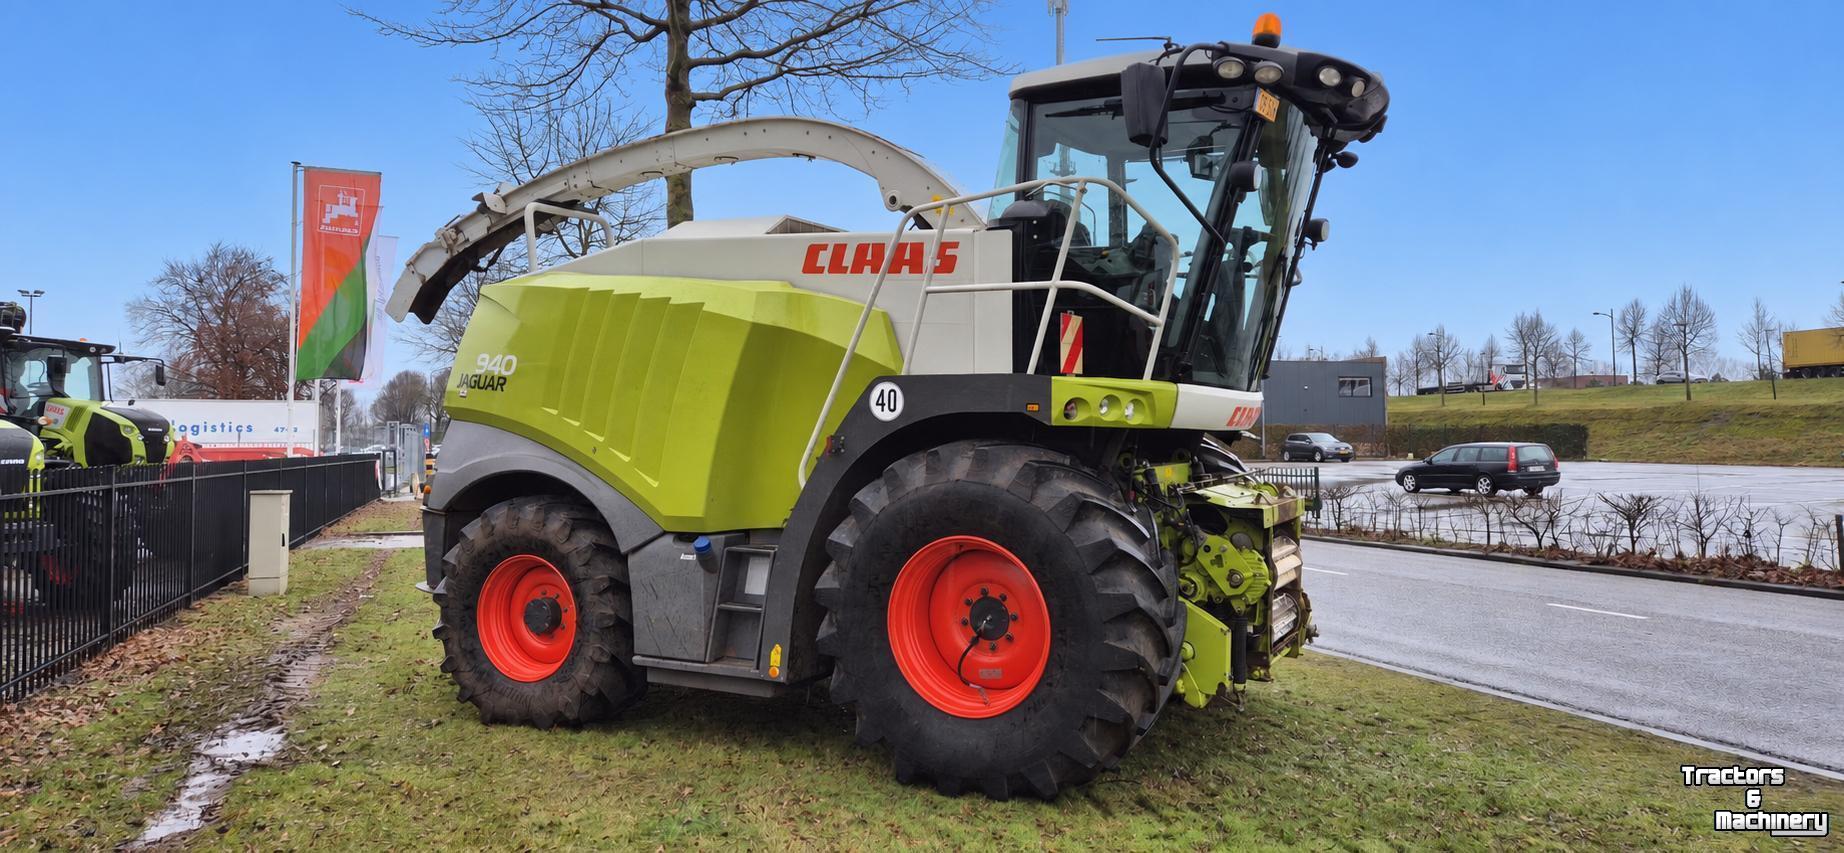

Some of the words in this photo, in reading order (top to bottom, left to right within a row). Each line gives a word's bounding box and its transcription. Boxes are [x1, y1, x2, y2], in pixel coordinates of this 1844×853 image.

[801, 241, 960, 275] CLAAS
[475, 352, 518, 376] 940
[456, 372, 508, 392] JAGUAR
[875, 388, 897, 413] 40
